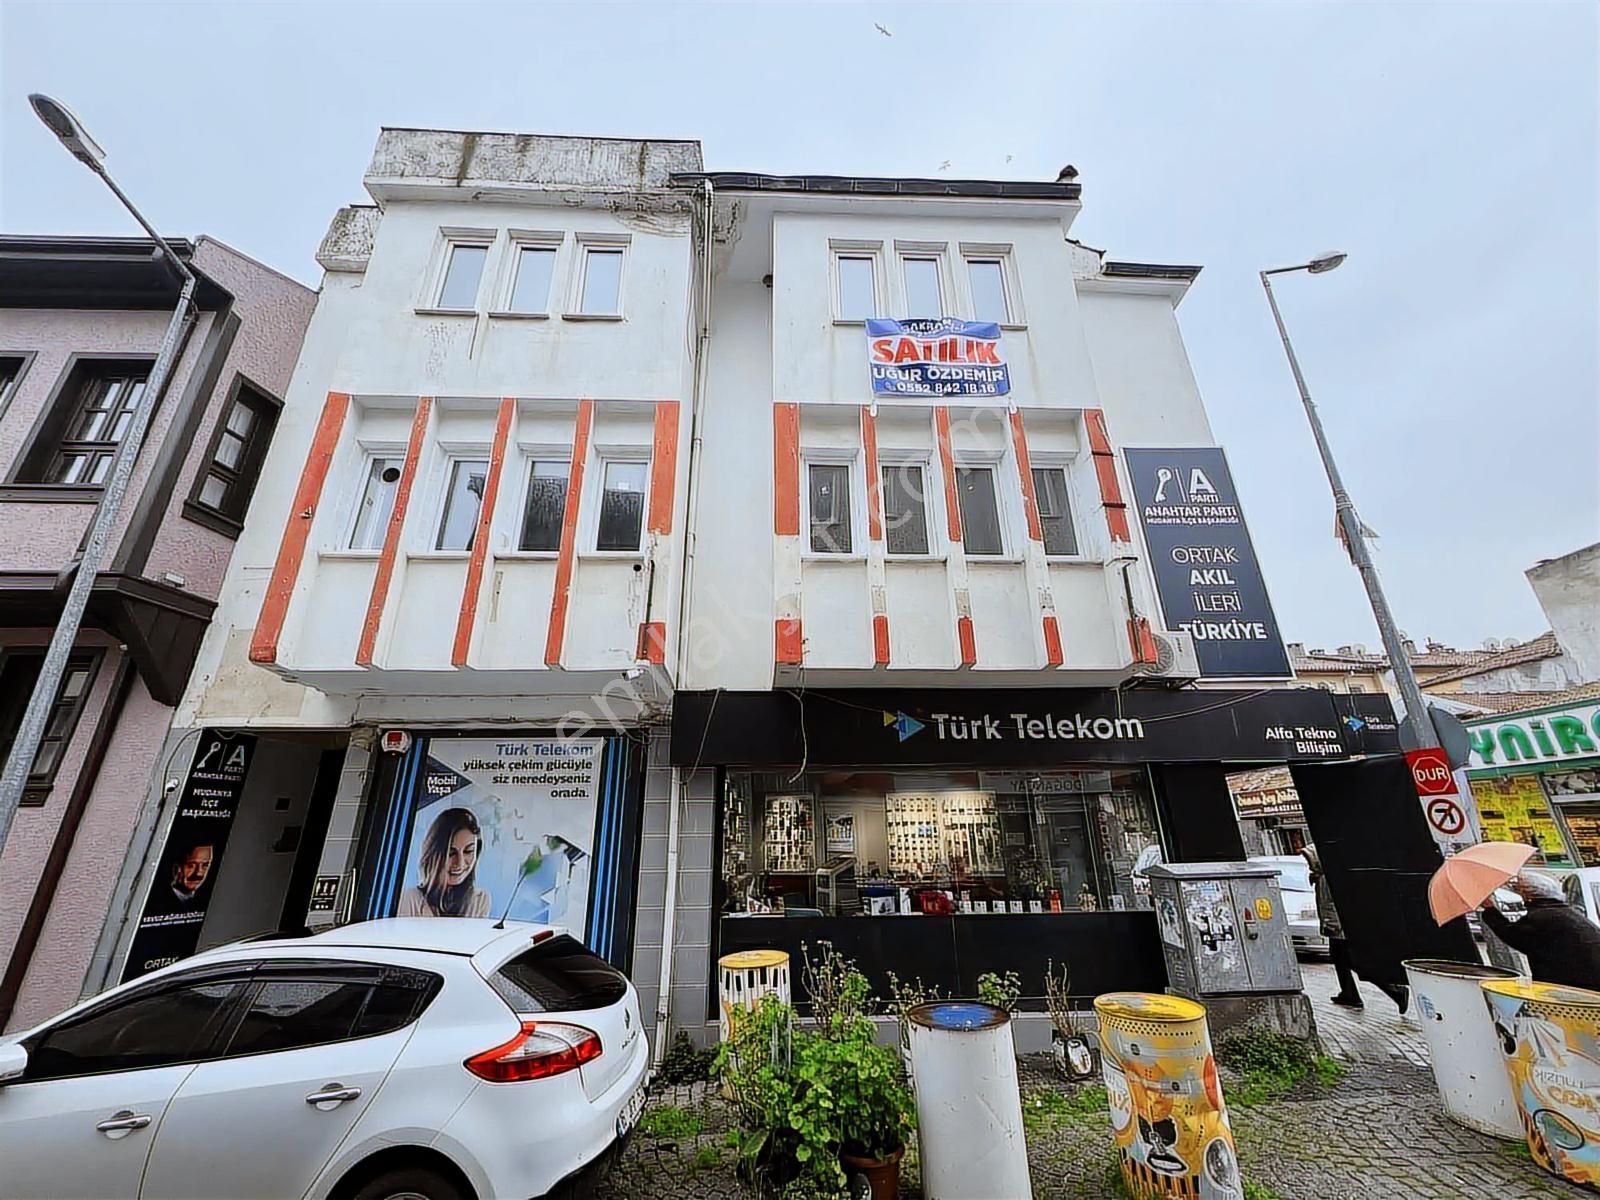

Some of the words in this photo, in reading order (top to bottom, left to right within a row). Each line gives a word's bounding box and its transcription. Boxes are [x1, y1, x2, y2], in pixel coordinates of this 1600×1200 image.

[873, 338, 1000, 363] SATILIK
[873, 366, 921, 381] UĞUR
[927, 365, 1004, 382] ÖZDEMİR
[897, 382, 931, 393] 0552
[935, 382, 961, 393] 842
[1190, 469, 1216, 493] A
[1145, 506, 1201, 516] ANAHTAR
[1172, 547, 1239, 564] ORTAK
[1190, 569, 1235, 585] AKIL
[1193, 591, 1241, 611] İLERİ
[1179, 619, 1268, 640] TÜRKİYE
[931, 713, 1002, 740] Türk
[1010, 713, 1145, 740] Telekom
[1265, 727, 1294, 739] Alfa
[1295, 727, 1337, 739] Tekno
[227, 745, 245, 767] A
[496, 744, 529, 755] Türk
[533, 744, 593, 755] Telekom
[1296, 741, 1342, 756] Bilişim
[463, 759, 505, 772] yüksek
[508, 759, 543, 772] çekim
[546, 759, 593, 772] gücüyle
[492, 773, 509, 784] siz
[512, 773, 591, 785] neredeyseniz
[1415, 767, 1448, 782] DUR
[551, 787, 589, 798] orada.
